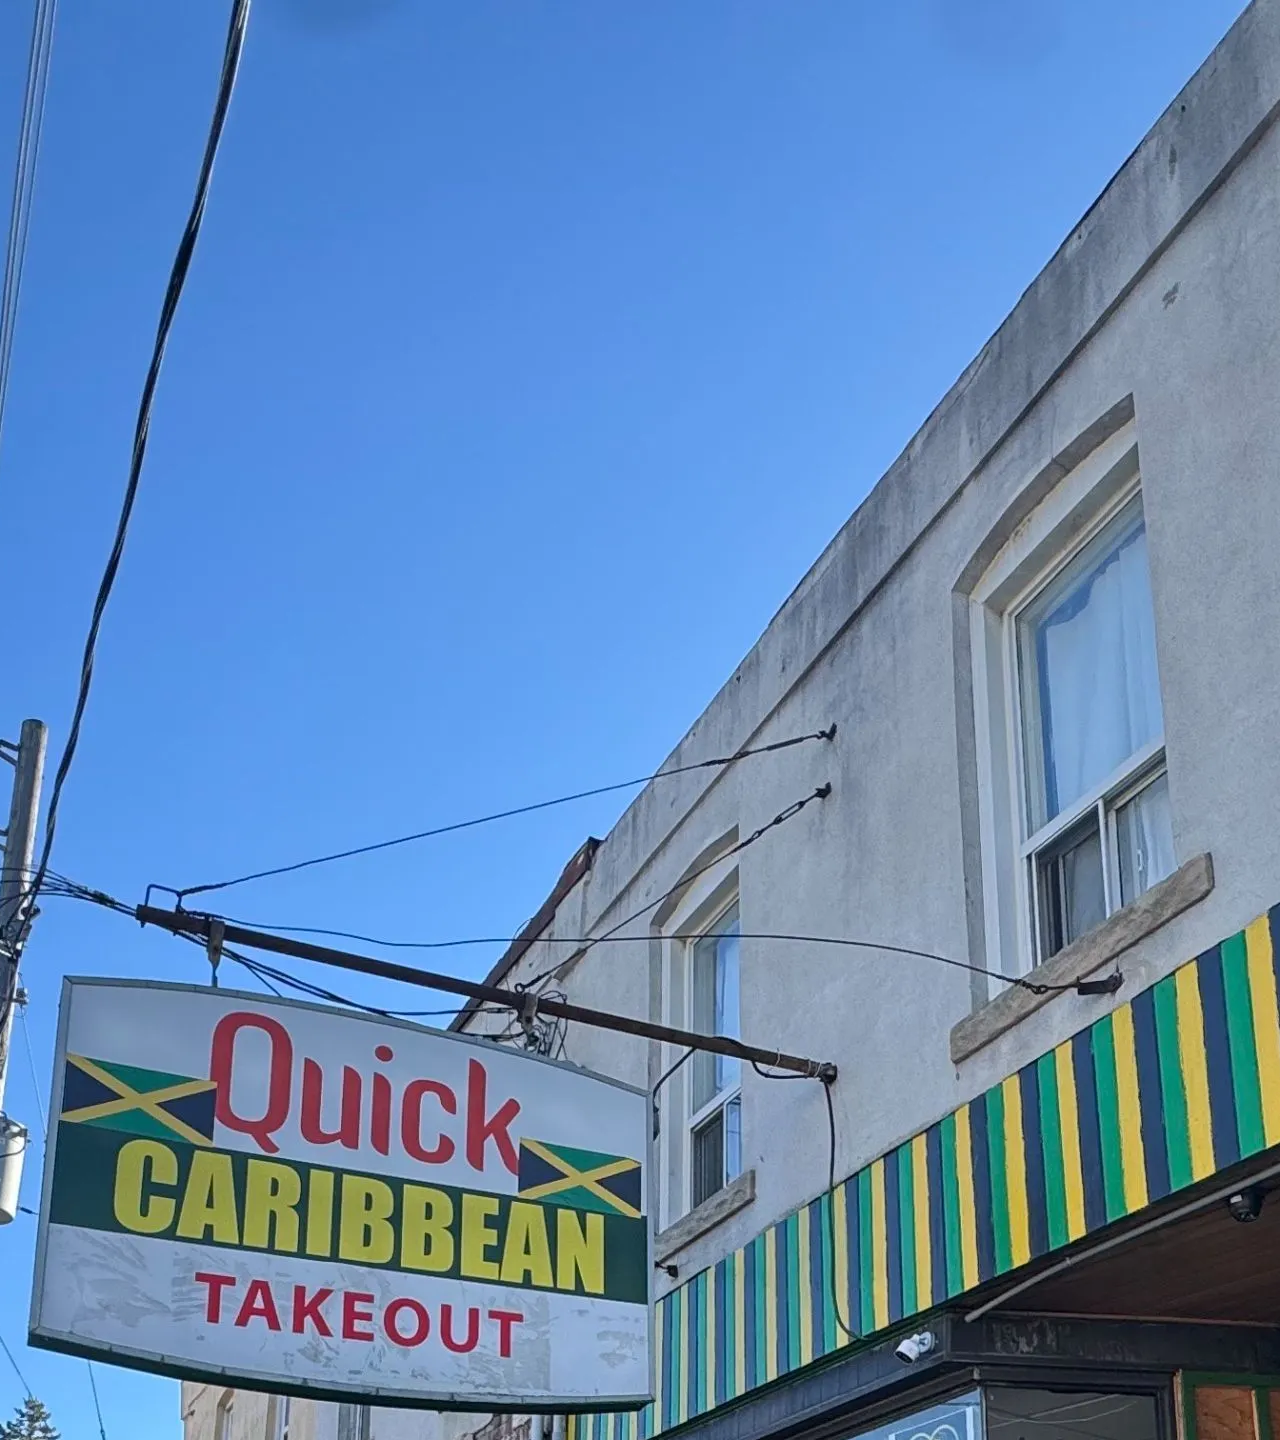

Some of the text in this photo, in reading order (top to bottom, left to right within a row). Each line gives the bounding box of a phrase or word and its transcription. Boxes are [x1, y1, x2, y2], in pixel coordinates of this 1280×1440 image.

[210, 1011, 521, 1176] Quick
[114, 1139, 605, 1295] CARIBBEAN
[194, 1272, 524, 1358] TAKEOUT
